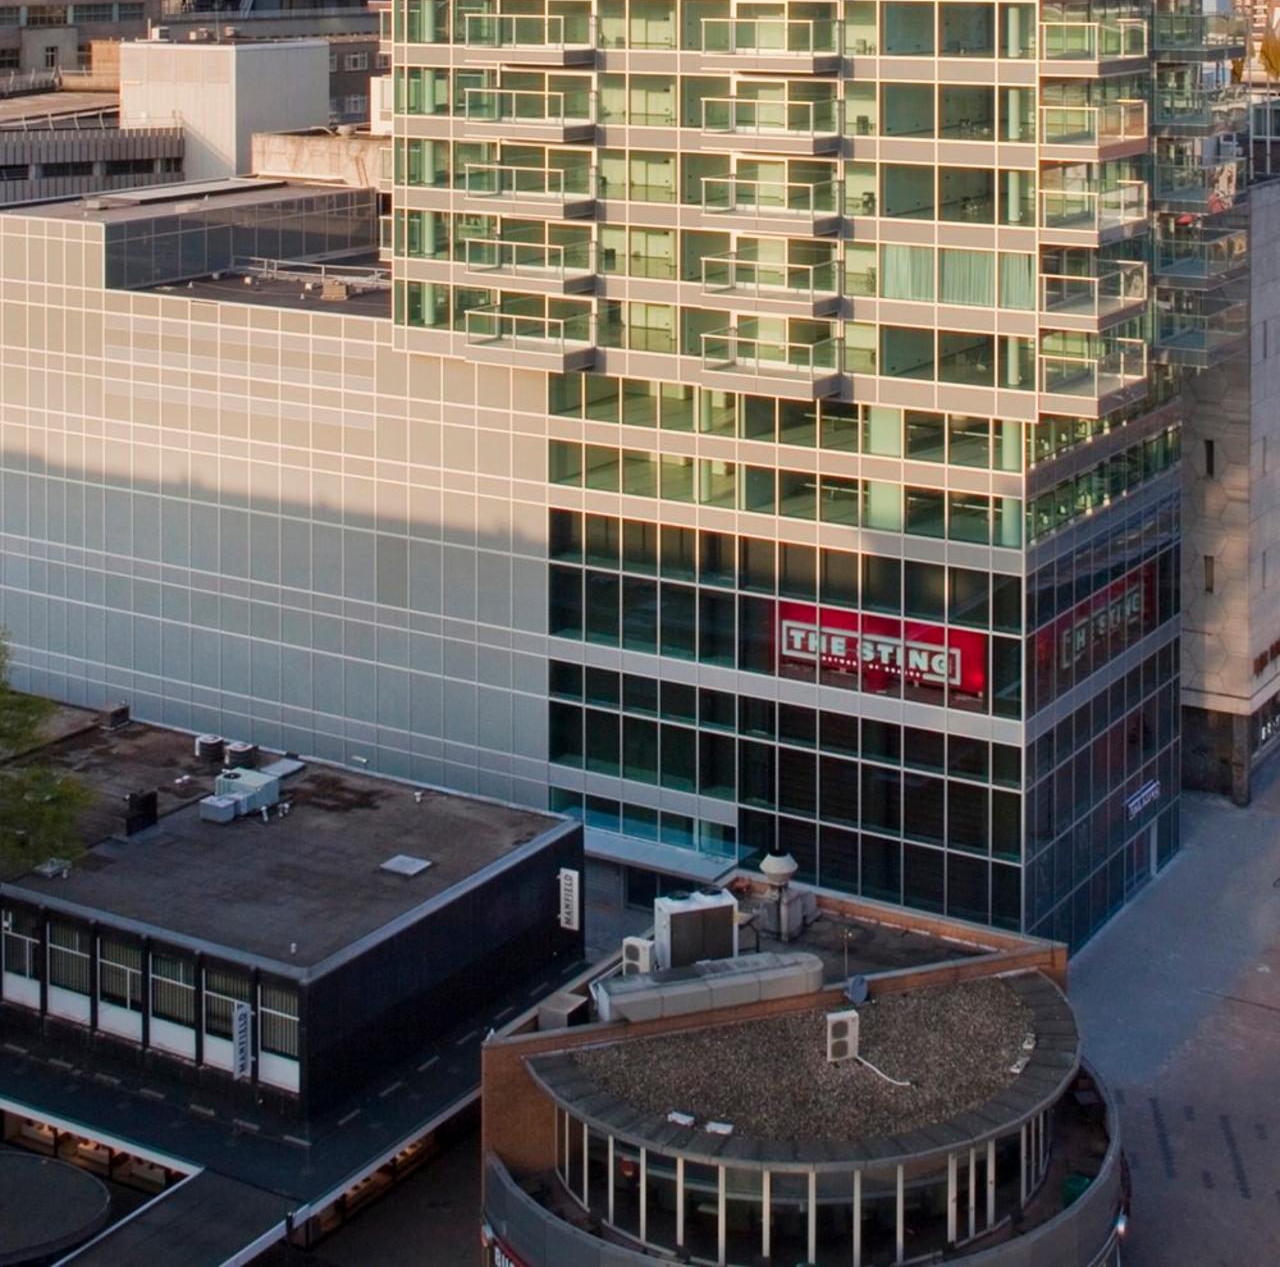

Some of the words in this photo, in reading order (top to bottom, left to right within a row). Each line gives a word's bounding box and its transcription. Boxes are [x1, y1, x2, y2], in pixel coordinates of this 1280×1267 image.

[789, 629, 846, 657] THE
[856, 640, 950, 675] STING
[564, 874, 573, 926] MANFIELD
[238, 1012, 247, 1074] MANFIELD
